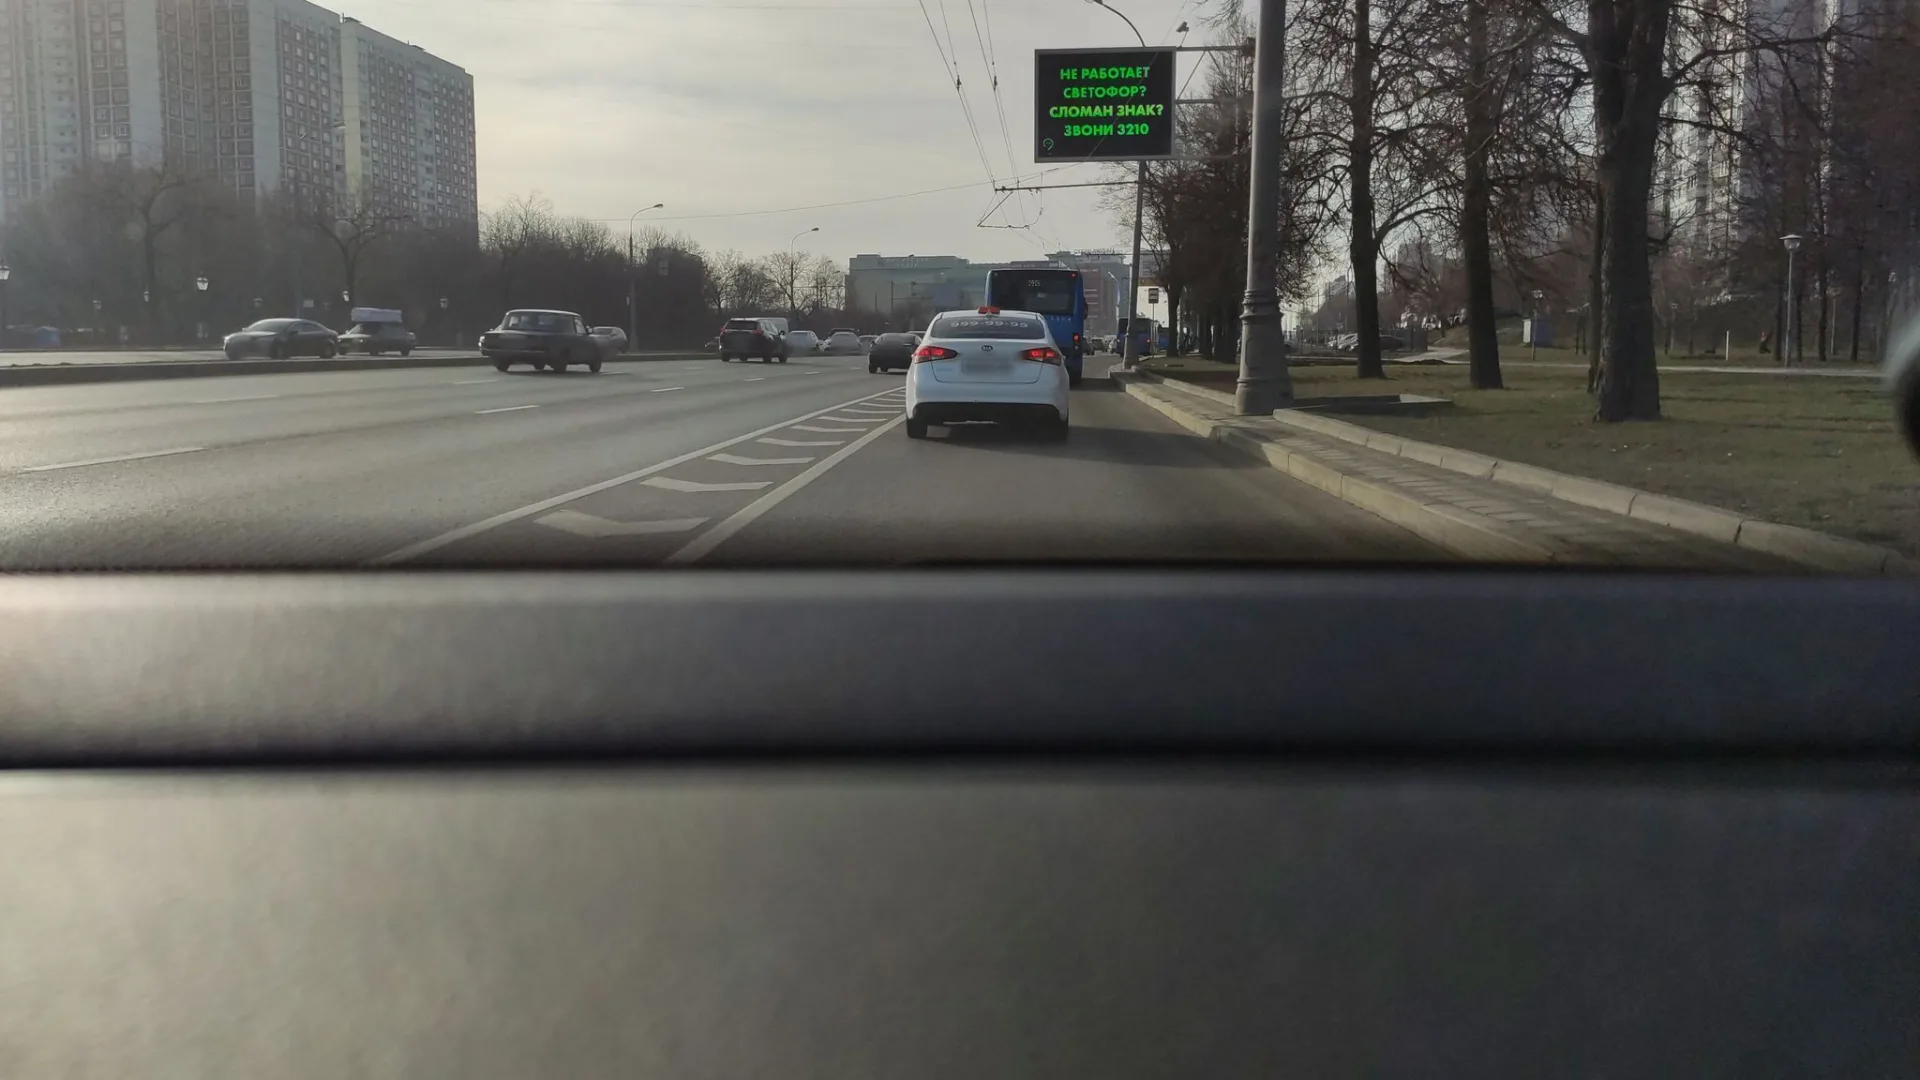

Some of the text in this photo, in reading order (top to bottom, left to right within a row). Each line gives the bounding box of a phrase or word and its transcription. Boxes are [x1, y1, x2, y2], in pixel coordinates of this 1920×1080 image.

[1060, 66, 1150, 79] НЕ РАБОТАЕТ
[1063, 85, 1147, 98] СВЕТОФОР?
[1049, 104, 1164, 118] СЛОМАН ЗНАК?
[1063, 123, 1150, 136] ЗВОНИ 3210
